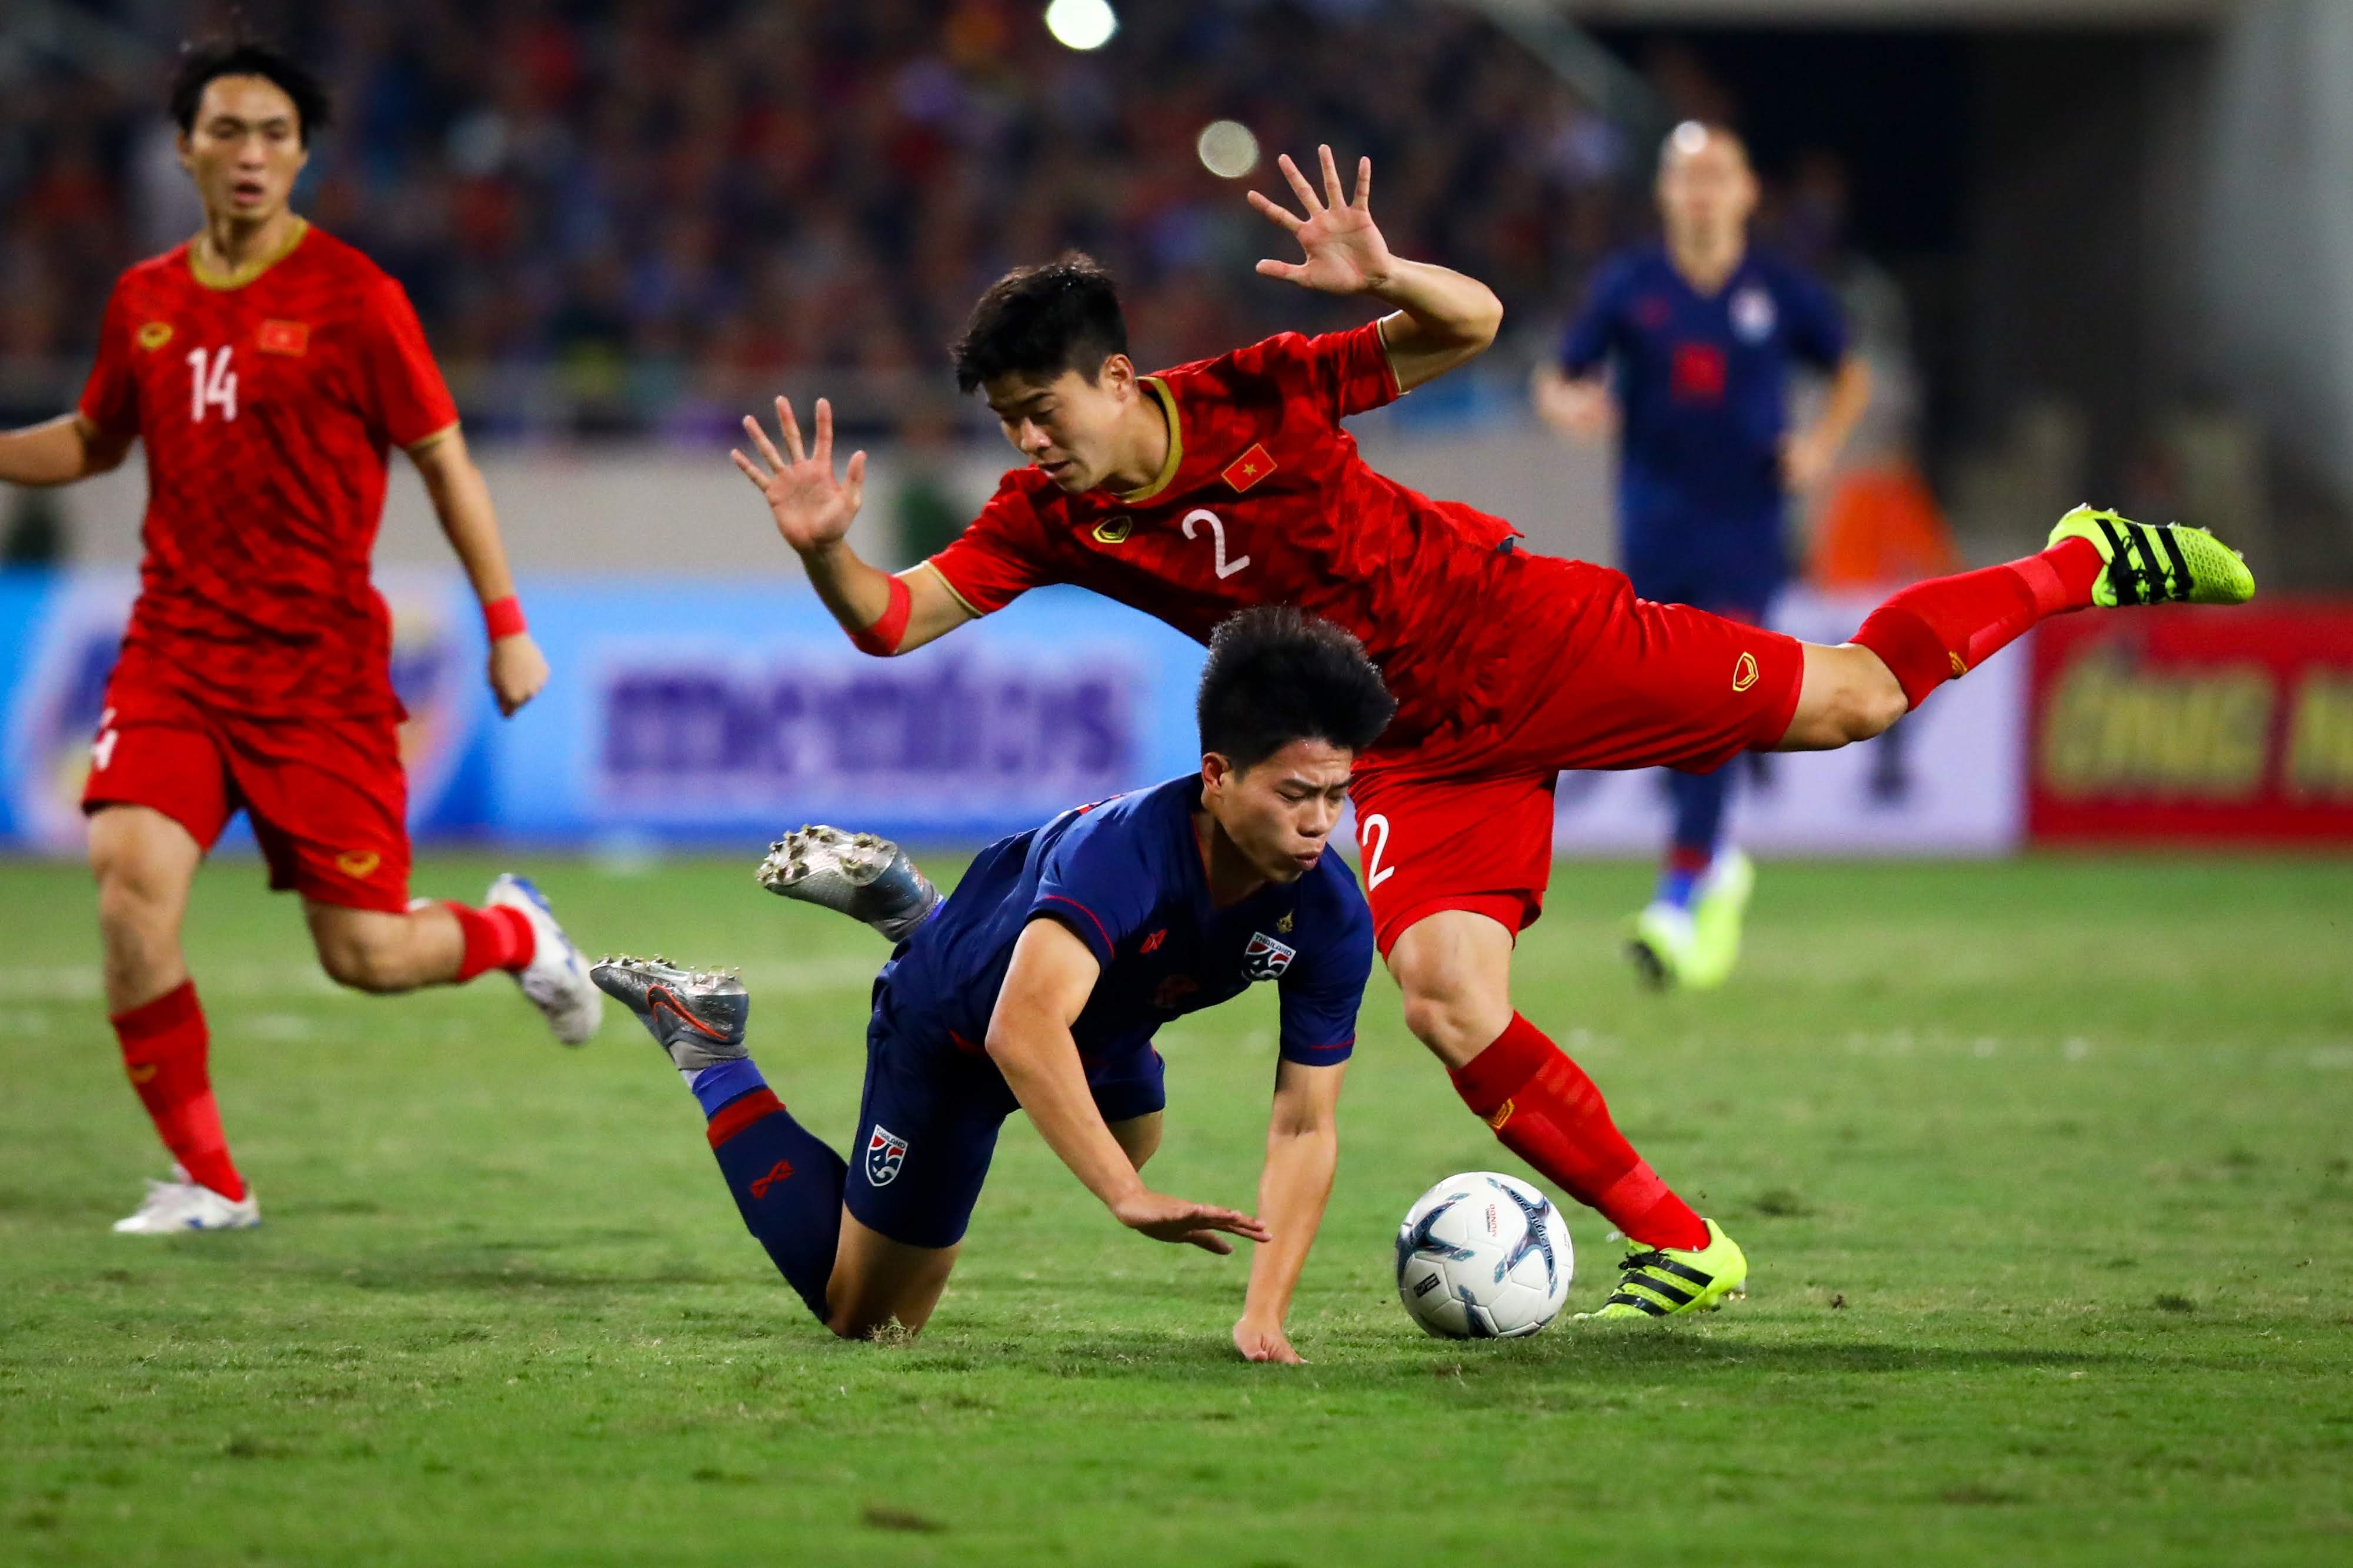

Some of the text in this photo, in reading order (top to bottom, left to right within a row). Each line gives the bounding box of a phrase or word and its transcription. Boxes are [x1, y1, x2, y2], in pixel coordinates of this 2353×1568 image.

[187, 345, 238, 423] 14
[1181, 509, 1251, 579] 2
[1362, 813, 1395, 892] 2
[1255, 934, 1292, 956] THAILAND
[876, 1127, 906, 1149] THAILAND
